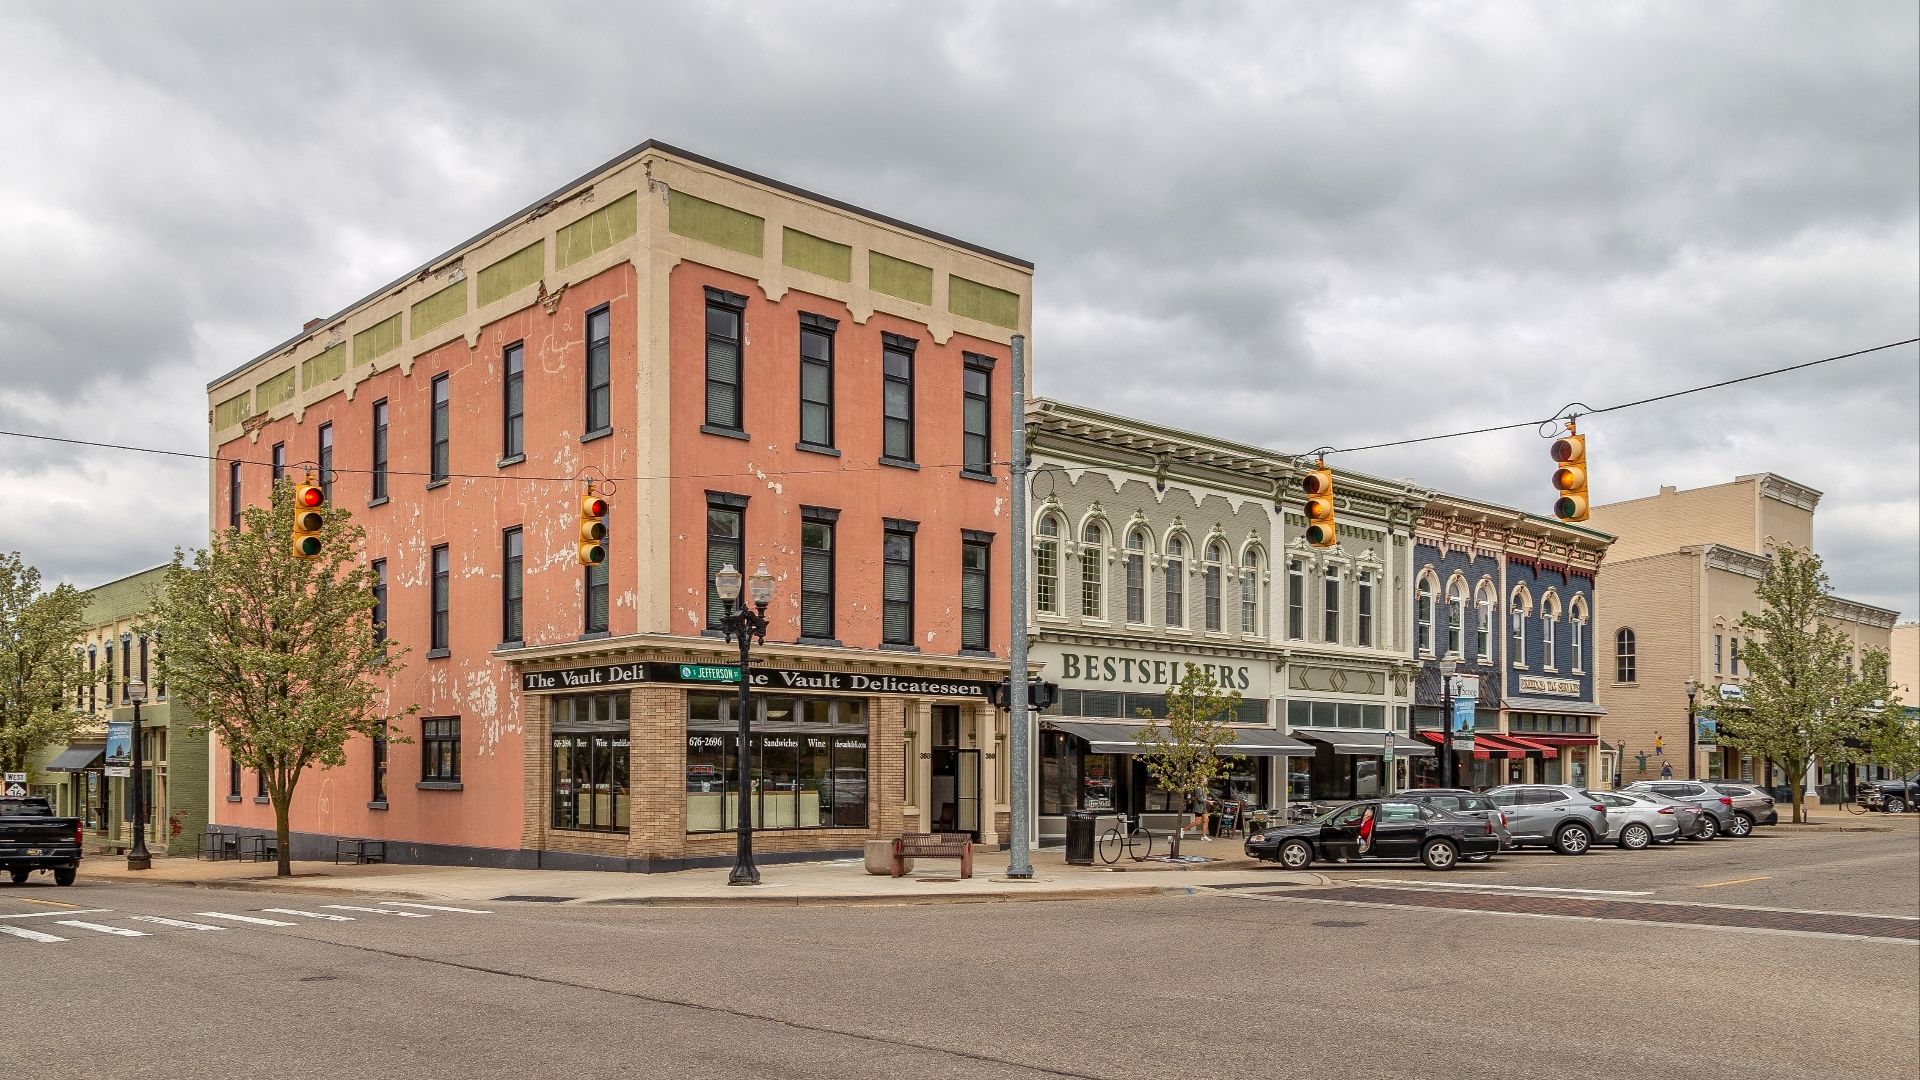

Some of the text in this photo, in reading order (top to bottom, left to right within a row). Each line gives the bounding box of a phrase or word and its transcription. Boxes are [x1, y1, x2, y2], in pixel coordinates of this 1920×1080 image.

[525, 664, 645, 688] The Vault Deli
[698, 667, 733, 679] JEFFERSON
[1061, 653, 1250, 690] BESTSELERS
[779, 671, 841, 689] Vault
[850, 675, 983, 695] Delicatessen
[689, 736, 722, 747] 676-2696
[763, 738, 799, 747] Sandwiches
[807, 738, 826, 748] Wine
[688, 766, 713, 774] OPEN
